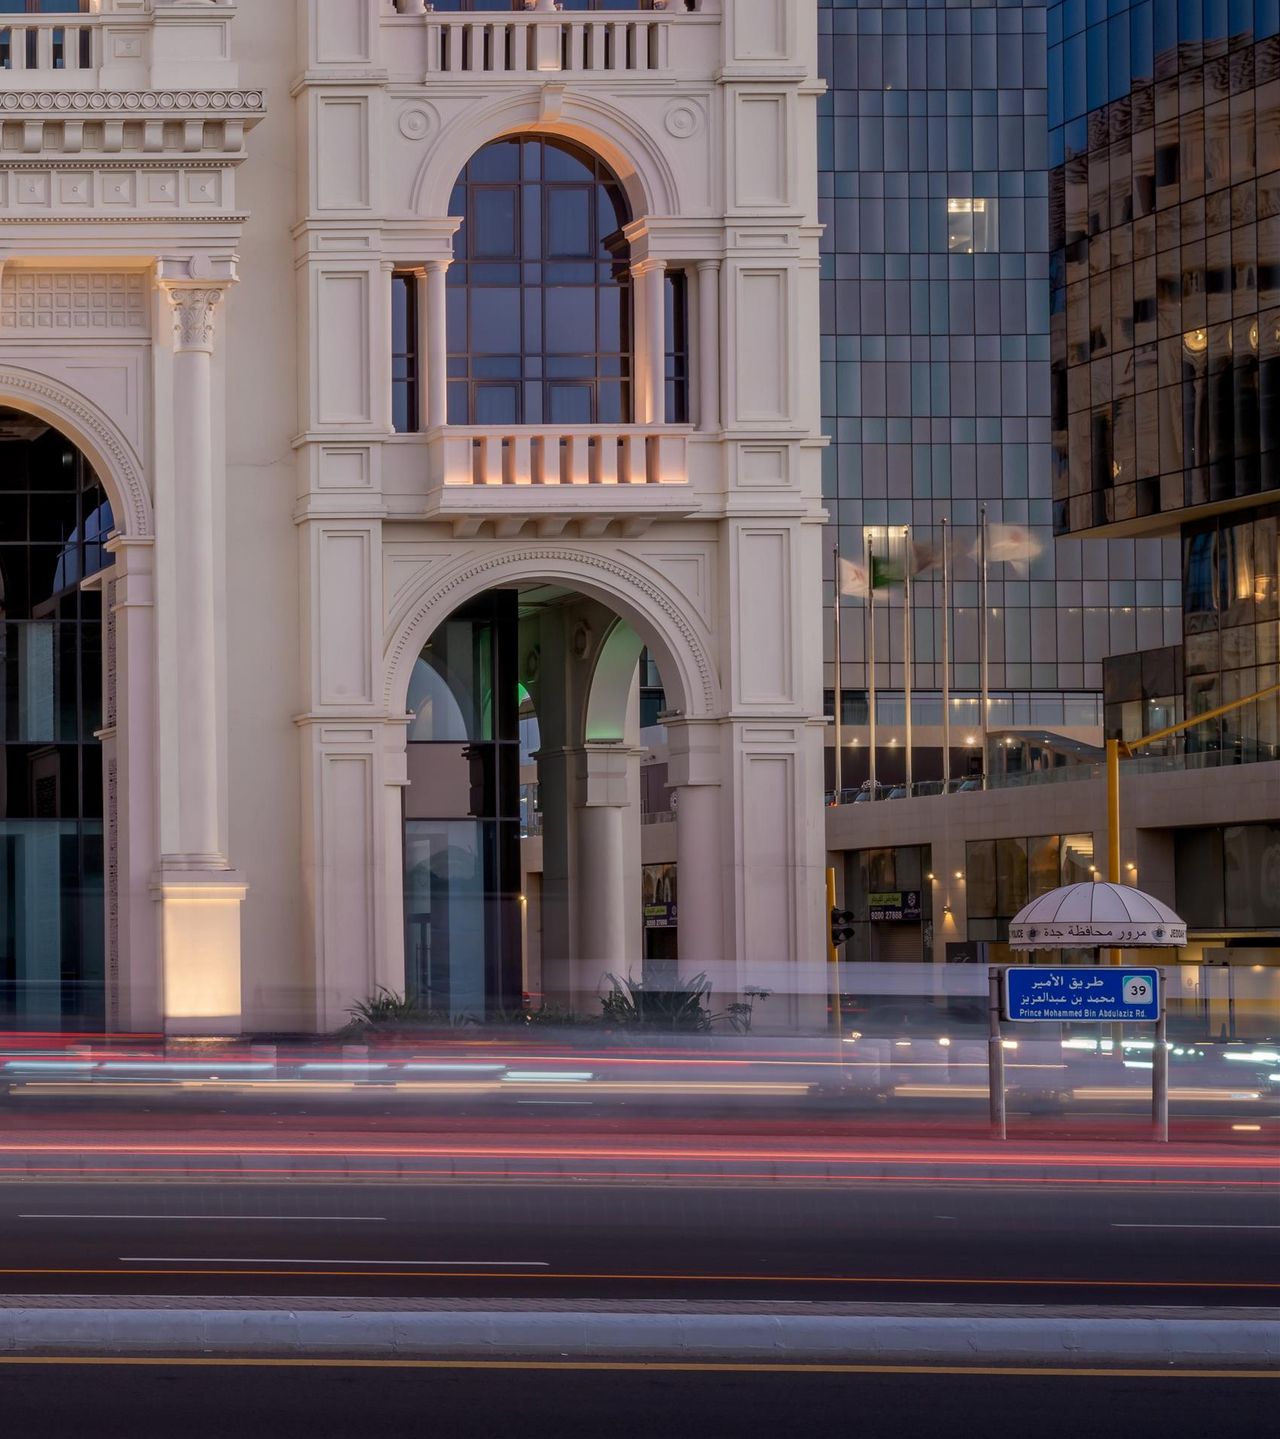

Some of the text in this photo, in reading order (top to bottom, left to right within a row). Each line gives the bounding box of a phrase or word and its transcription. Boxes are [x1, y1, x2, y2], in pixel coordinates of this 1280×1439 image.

[1044, 924, 1147, 940] مرور محافظة جدة
[1069, 976, 1104, 990] طريق
[1130, 985, 1147, 996] 39
[1071, 994, 1083, 1006] بن
[1087, 995, 1116, 1004] محمد
[1020, 1008, 1042, 1017] Prince
[1043, 1008, 1083, 1017] Mohammed
[1084, 1008, 1097, 1017] Bin
[1098, 1008, 1134, 1018] Abdulaziz
